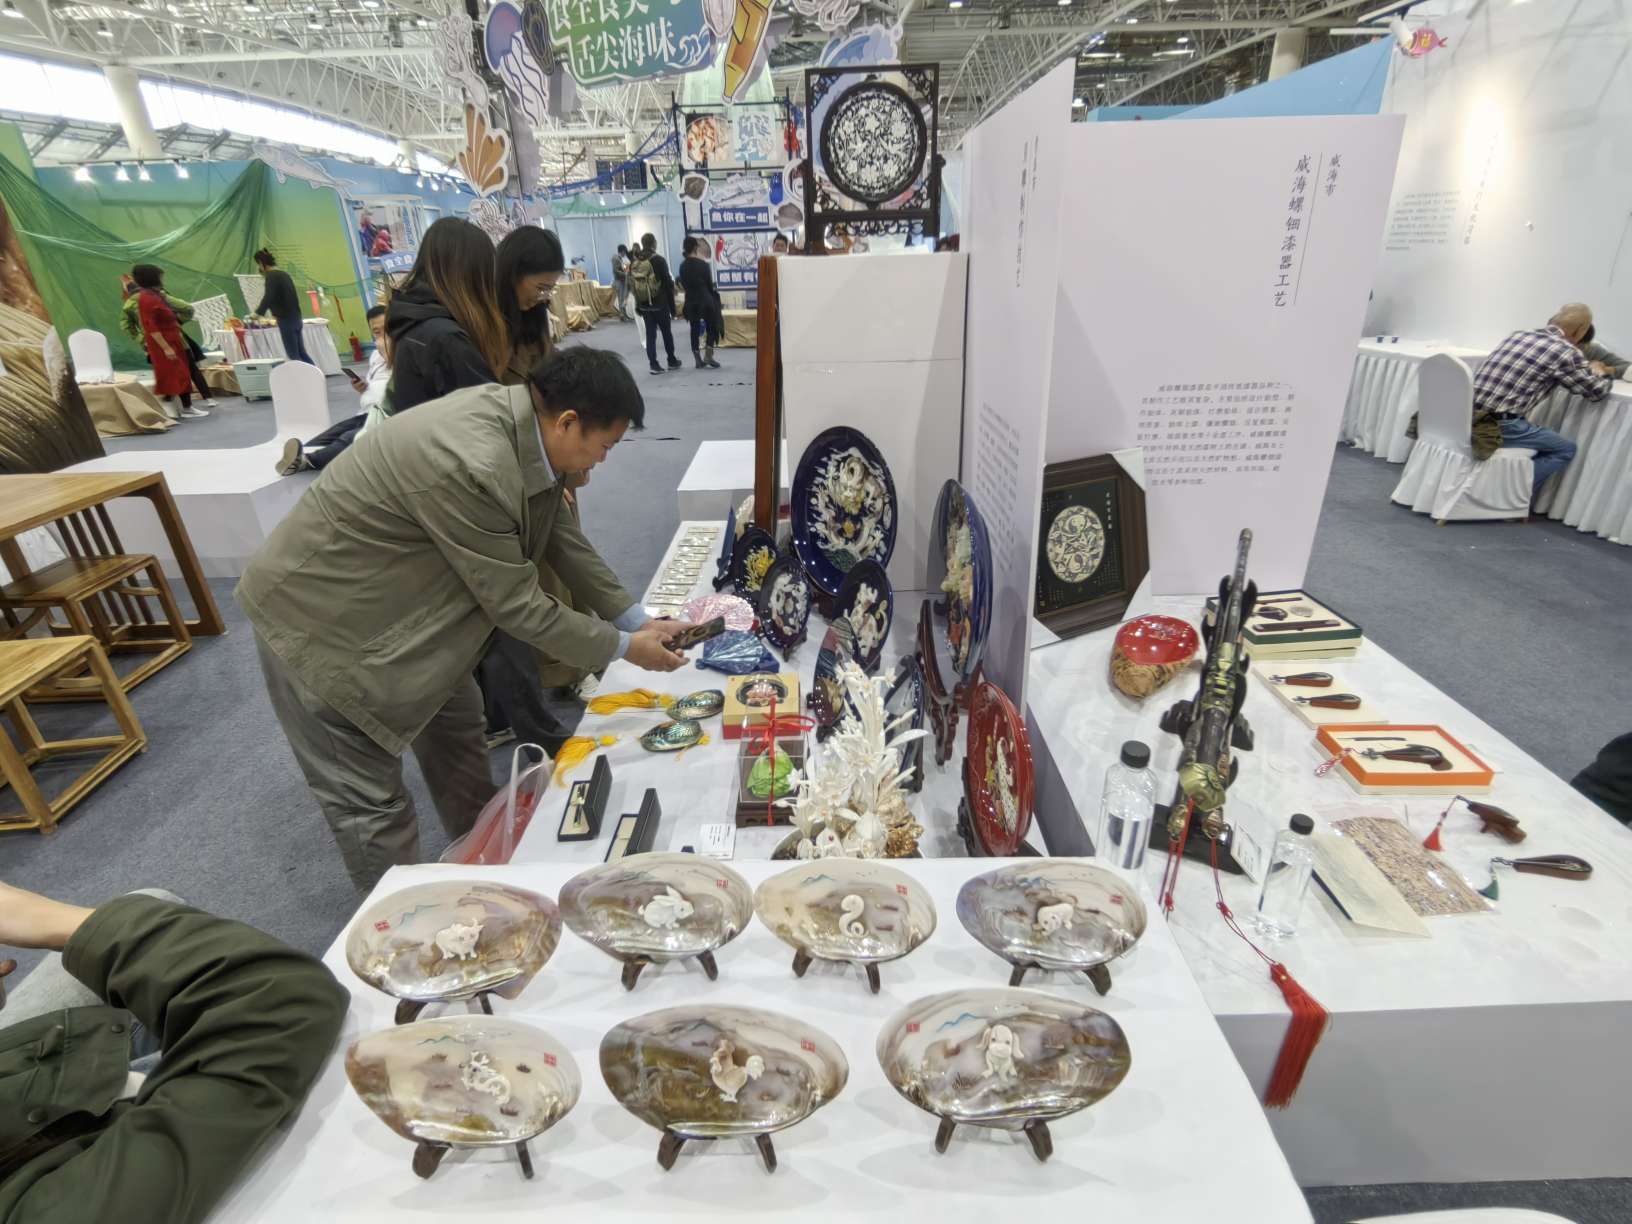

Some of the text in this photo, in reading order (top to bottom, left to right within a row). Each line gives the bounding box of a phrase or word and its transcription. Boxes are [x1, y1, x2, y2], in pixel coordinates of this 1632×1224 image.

[576, 16, 677, 76] 舌尖海味
[1273, 153, 1312, 308] 威海螺钿漆器工艺
